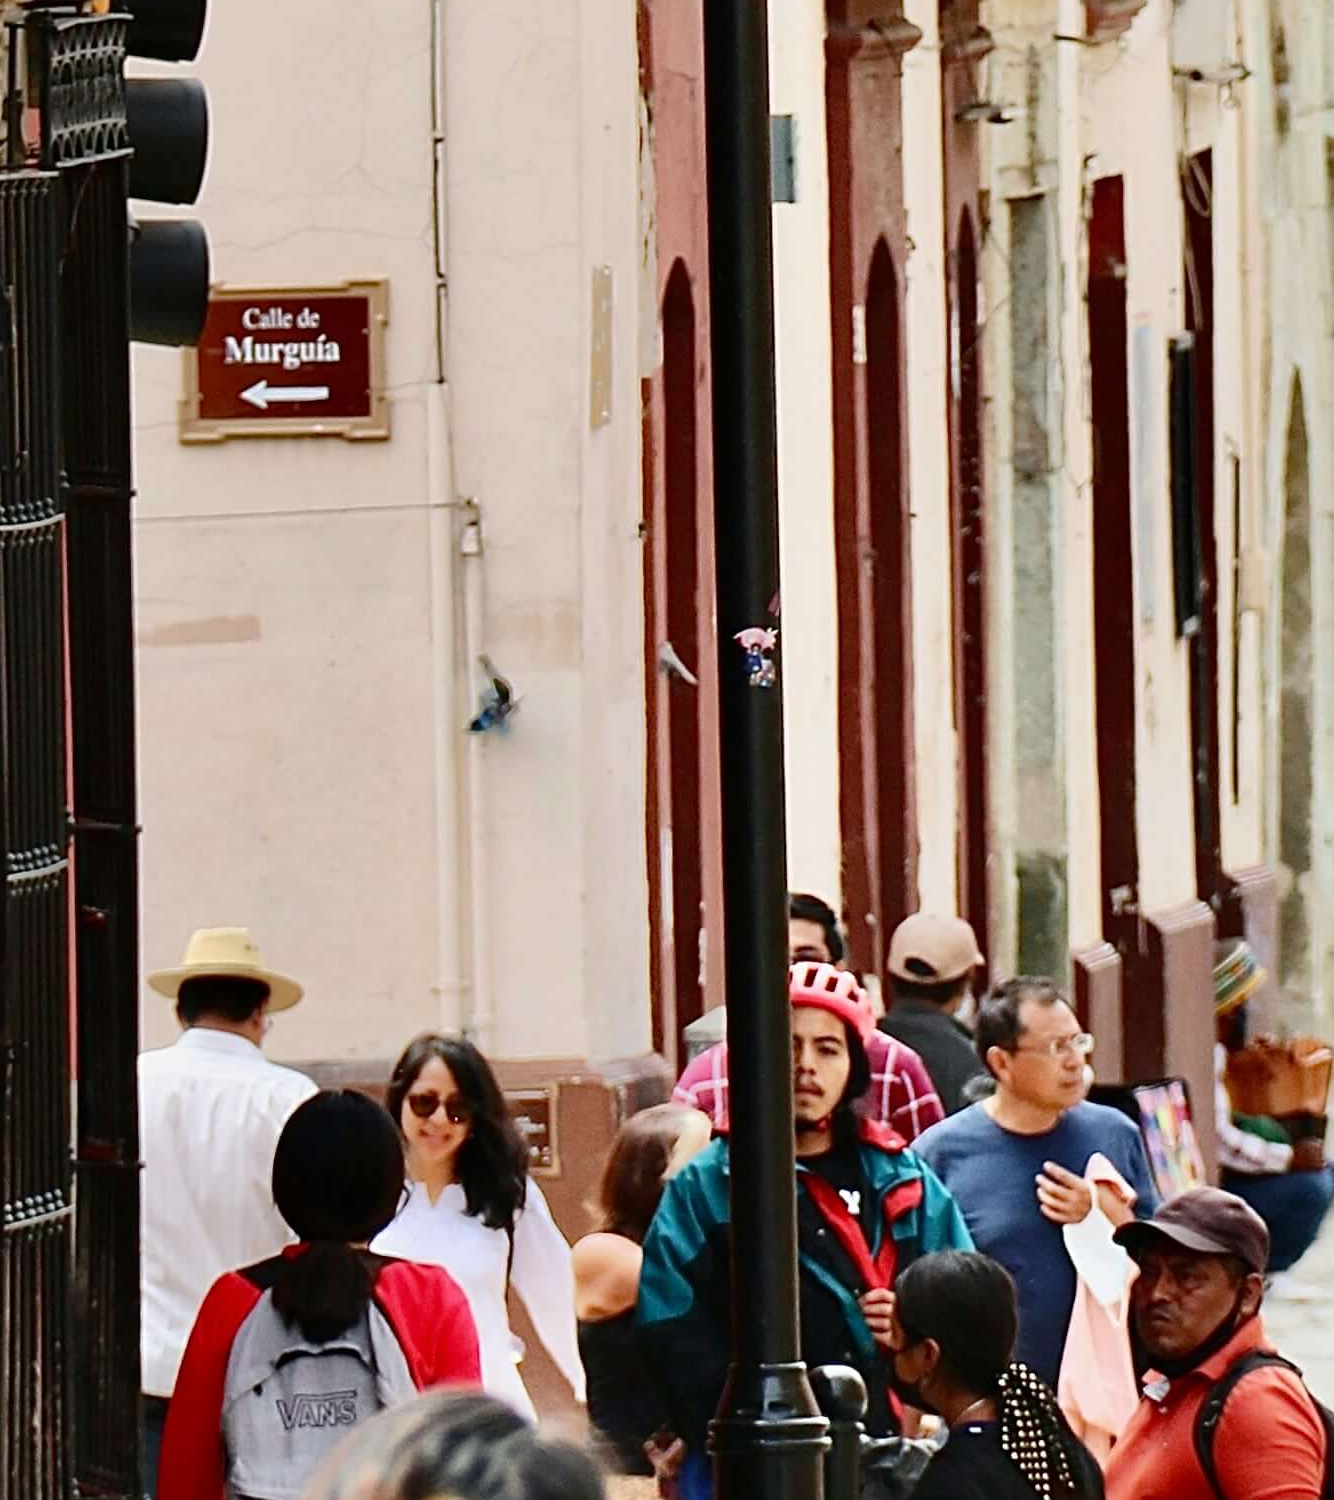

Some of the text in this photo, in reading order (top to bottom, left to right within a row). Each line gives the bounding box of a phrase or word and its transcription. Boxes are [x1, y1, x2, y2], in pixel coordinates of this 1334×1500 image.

[242, 307, 320, 330] Calle de
[224, 333, 341, 371] Murguía
[275, 1389, 358, 1430] VANS
